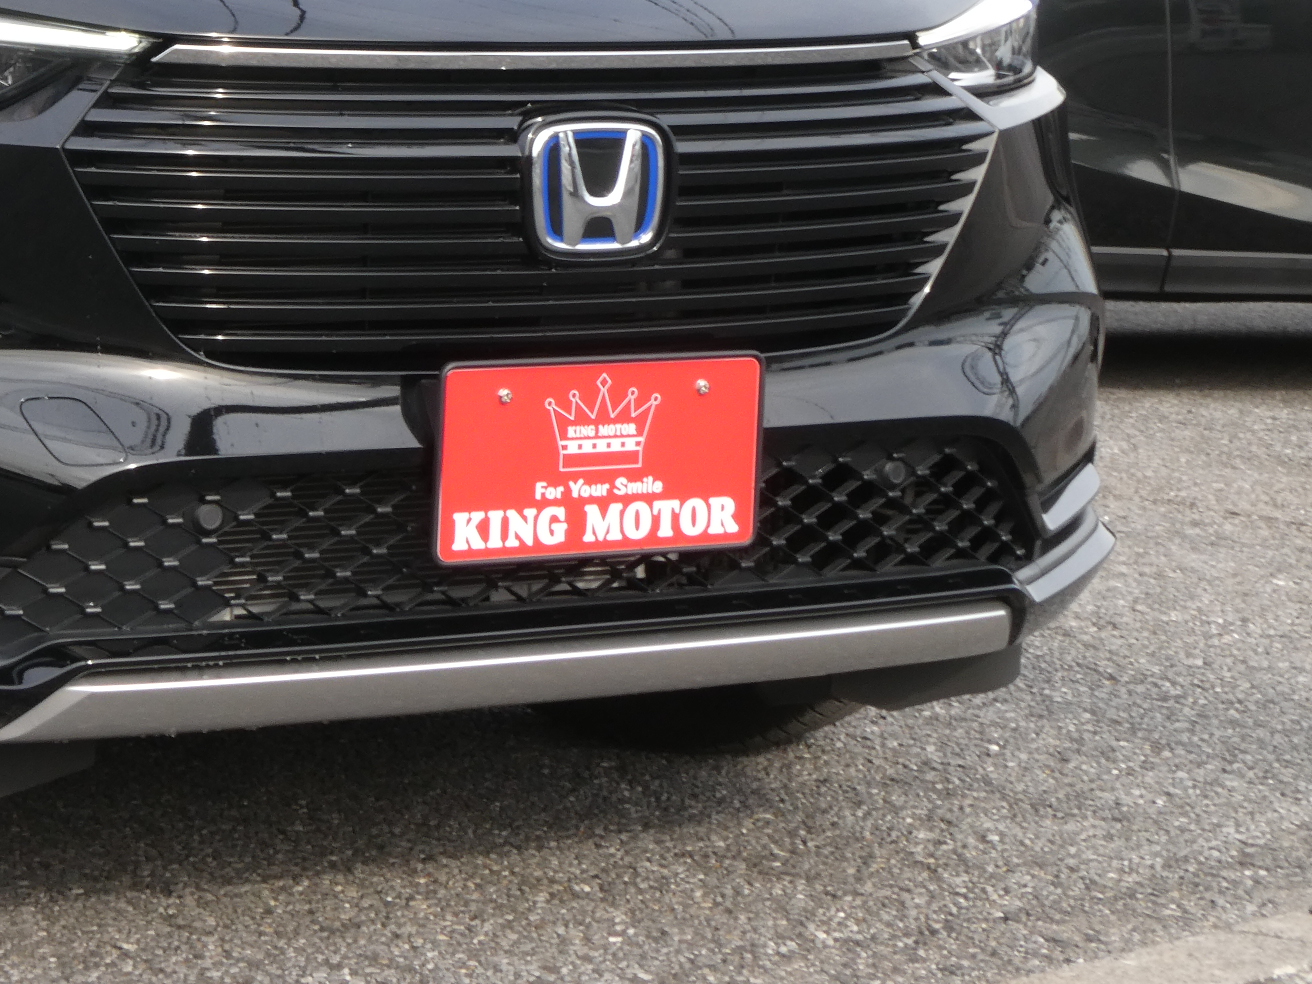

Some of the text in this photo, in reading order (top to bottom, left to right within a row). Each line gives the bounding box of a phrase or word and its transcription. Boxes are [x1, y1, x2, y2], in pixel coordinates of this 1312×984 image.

[567, 423, 637, 438] KING MOTOR
[535, 476, 663, 500] For Your Smile
[451, 496, 739, 551] KING MOTOR
